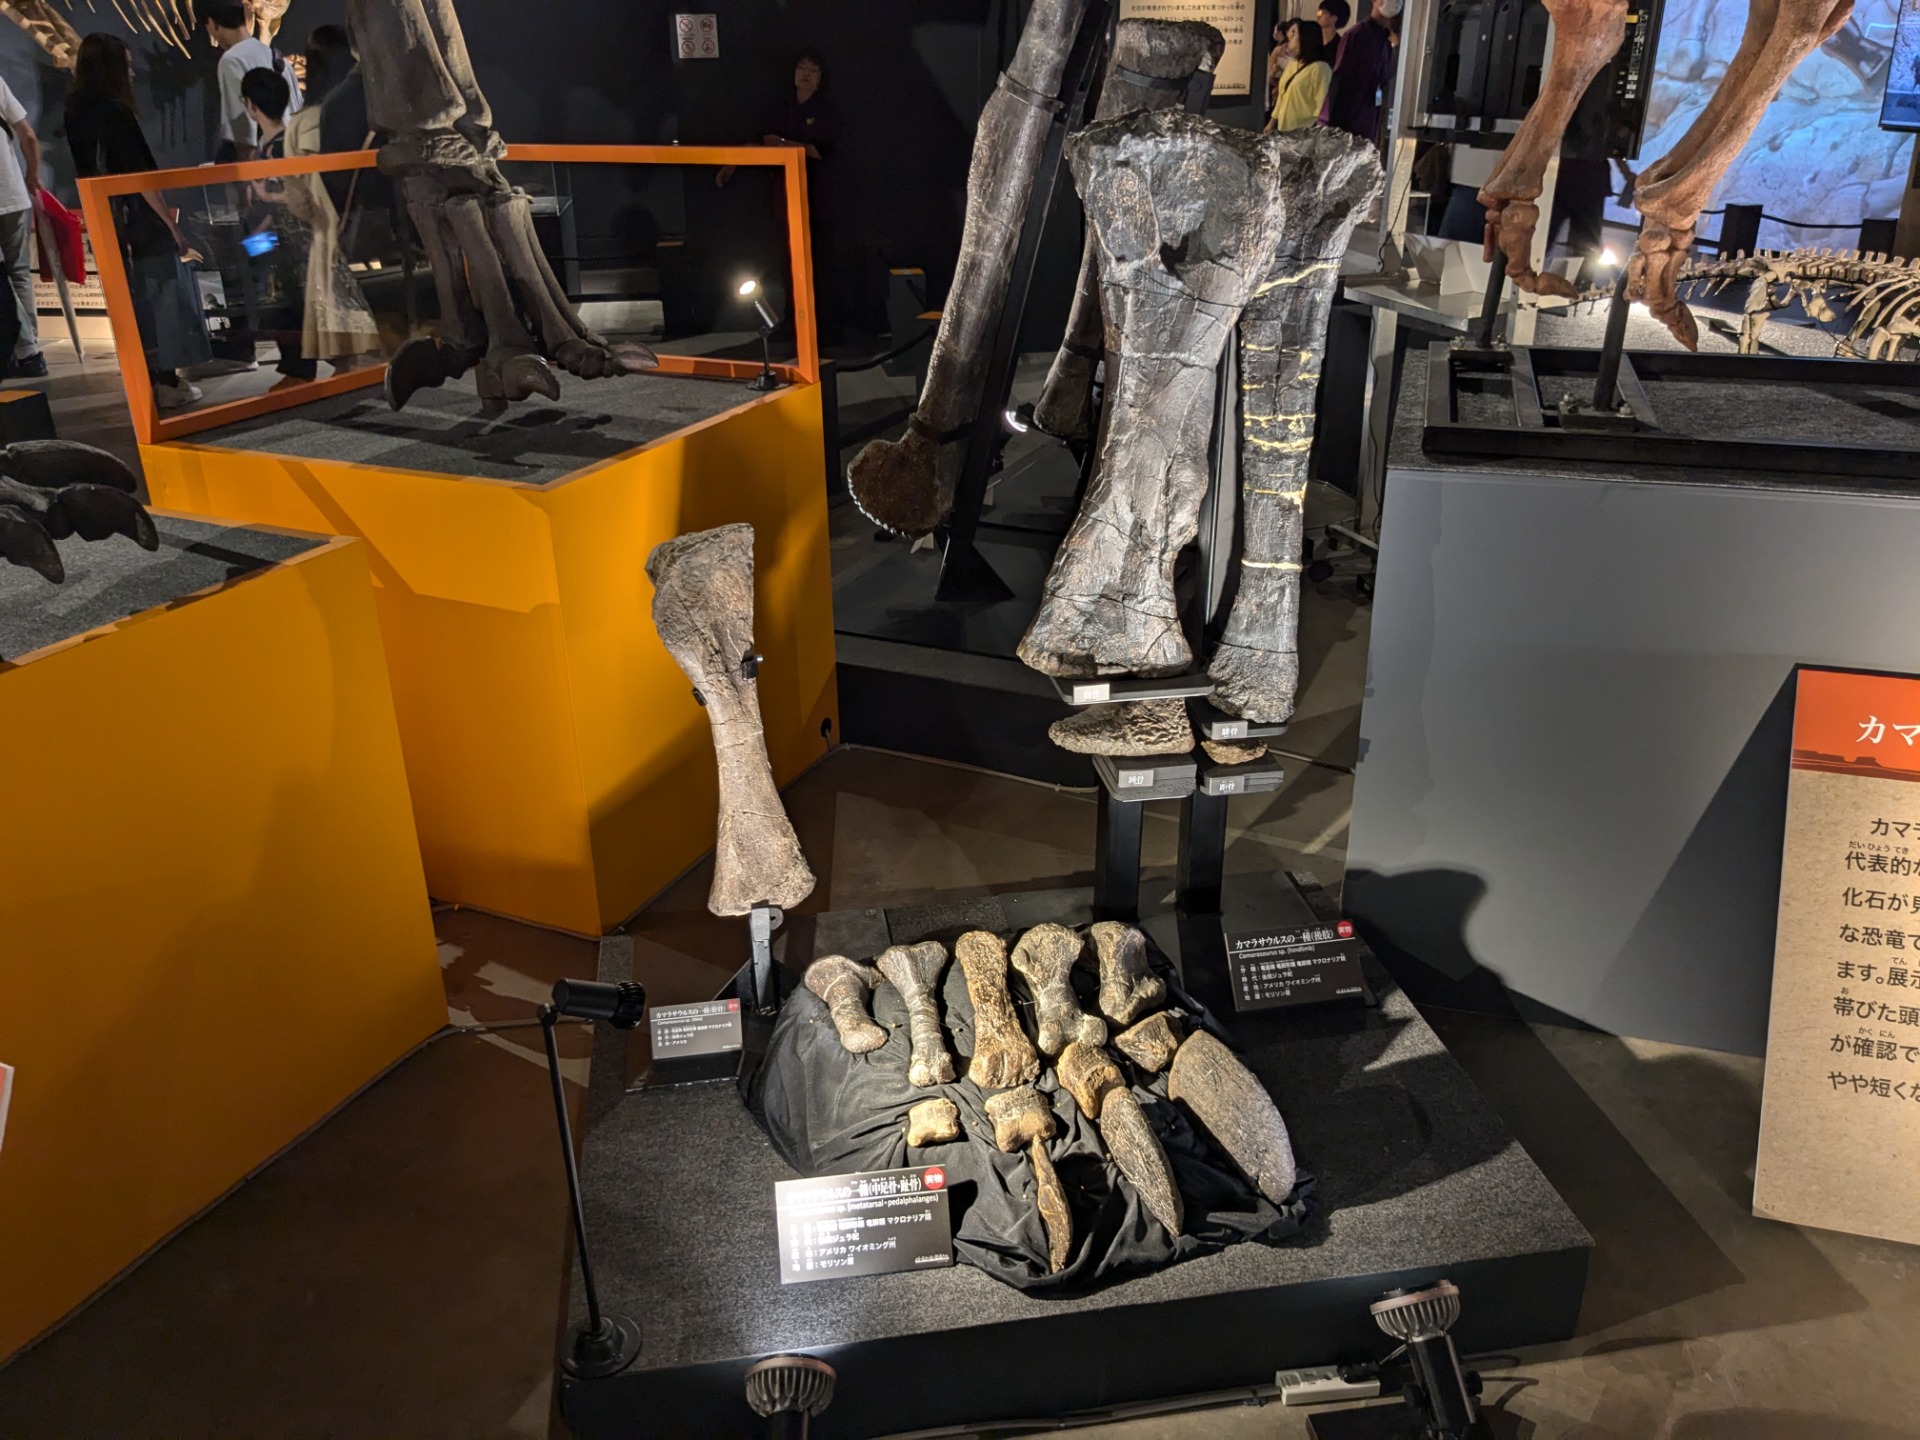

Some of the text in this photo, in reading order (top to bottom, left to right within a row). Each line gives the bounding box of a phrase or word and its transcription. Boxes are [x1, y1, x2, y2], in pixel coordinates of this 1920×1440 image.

[1855, 714, 1920, 746] カマ
[1848, 841, 1909, 854] だい ひょう てき
[1891, 957, 1907, 966] てん
[1840, 987, 1849, 995] お
[1858, 1027, 1896, 1038] かく にん
[818, 1247, 847, 1256] アメリカ
